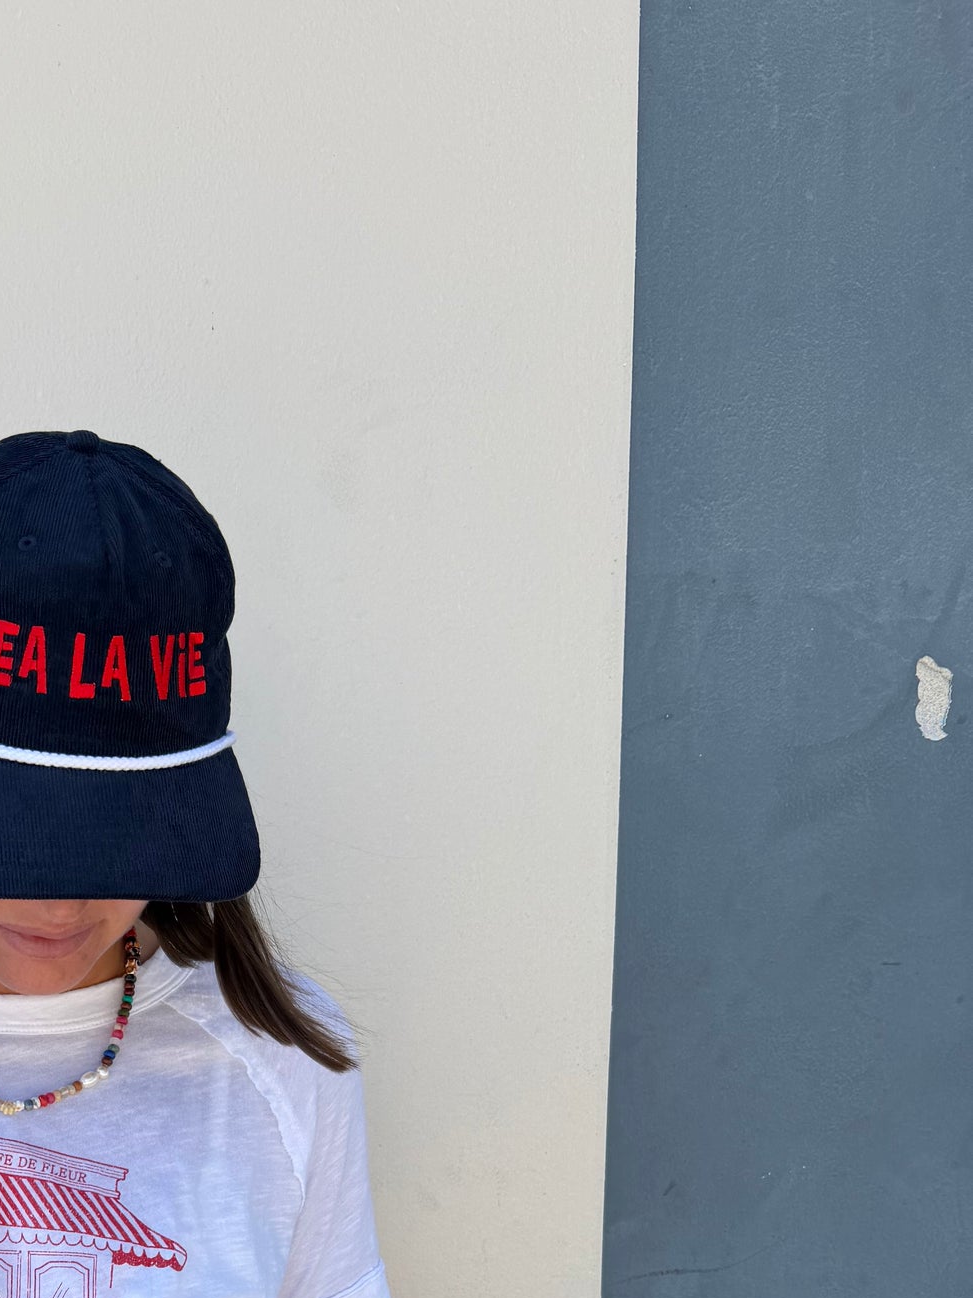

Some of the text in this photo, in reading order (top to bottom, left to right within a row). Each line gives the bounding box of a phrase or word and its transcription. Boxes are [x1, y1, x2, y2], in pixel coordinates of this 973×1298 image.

[69, 632, 131, 702] LA
[17, 1156, 37, 1171] DE
[41, 1163, 87, 1183] FLEUR
